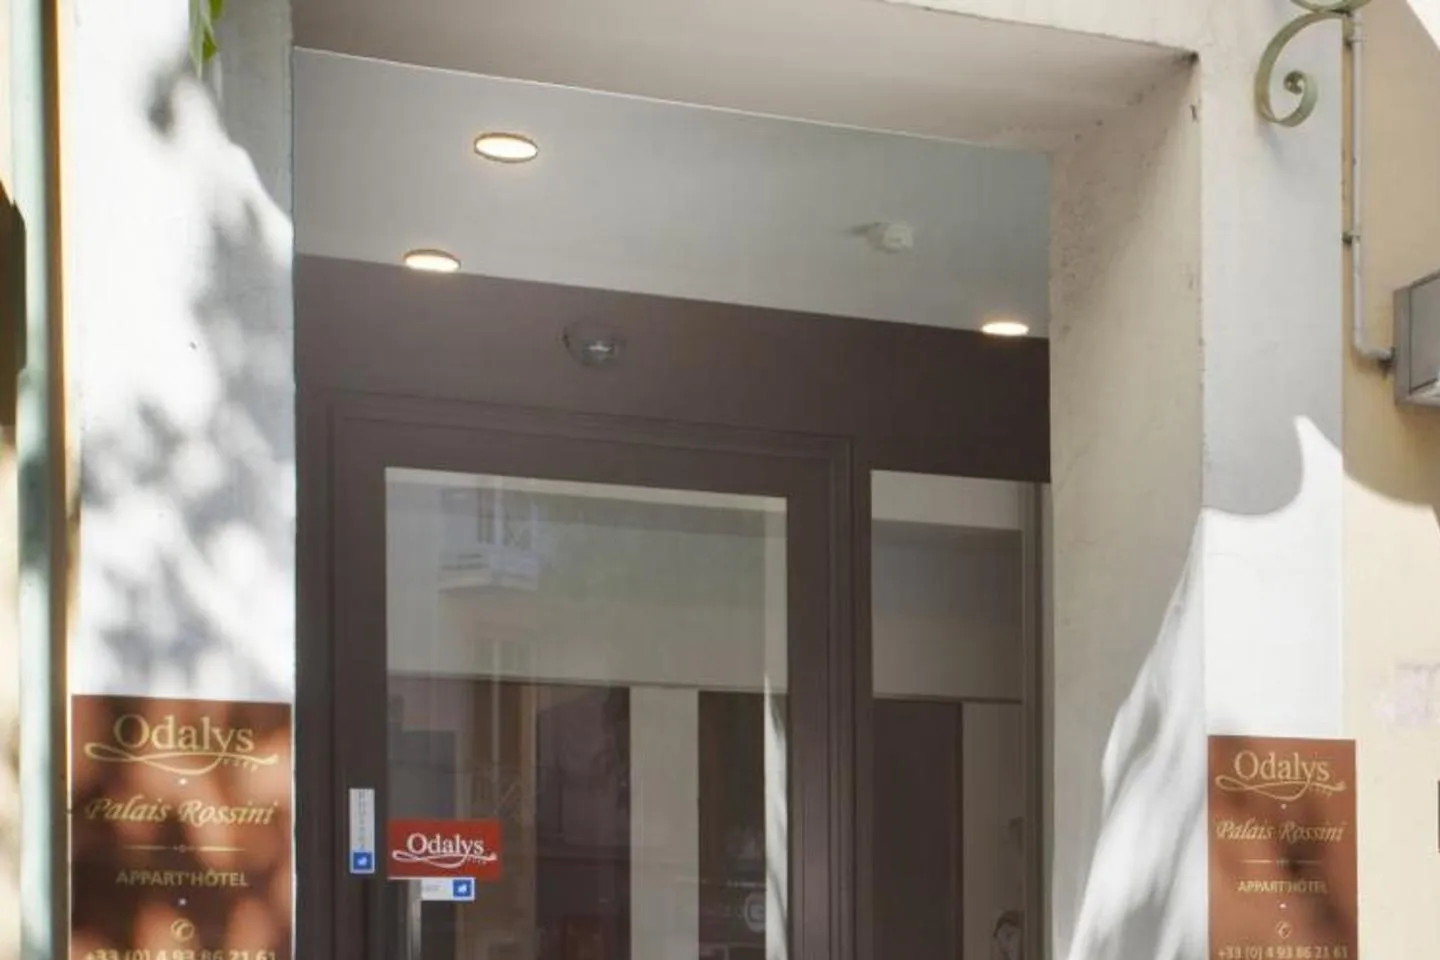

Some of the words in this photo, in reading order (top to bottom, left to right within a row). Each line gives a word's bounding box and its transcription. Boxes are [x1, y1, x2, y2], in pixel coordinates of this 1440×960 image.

[112, 713, 256, 760] Odalys
[1233, 750, 1331, 786] Odalys
[84, 795, 171, 823] Palais
[177, 799, 278, 828] Rossini
[406, 832, 485, 860] Odalys
[1216, 818, 1274, 841] Palais
[1279, 820, 1347, 844] Rossini
